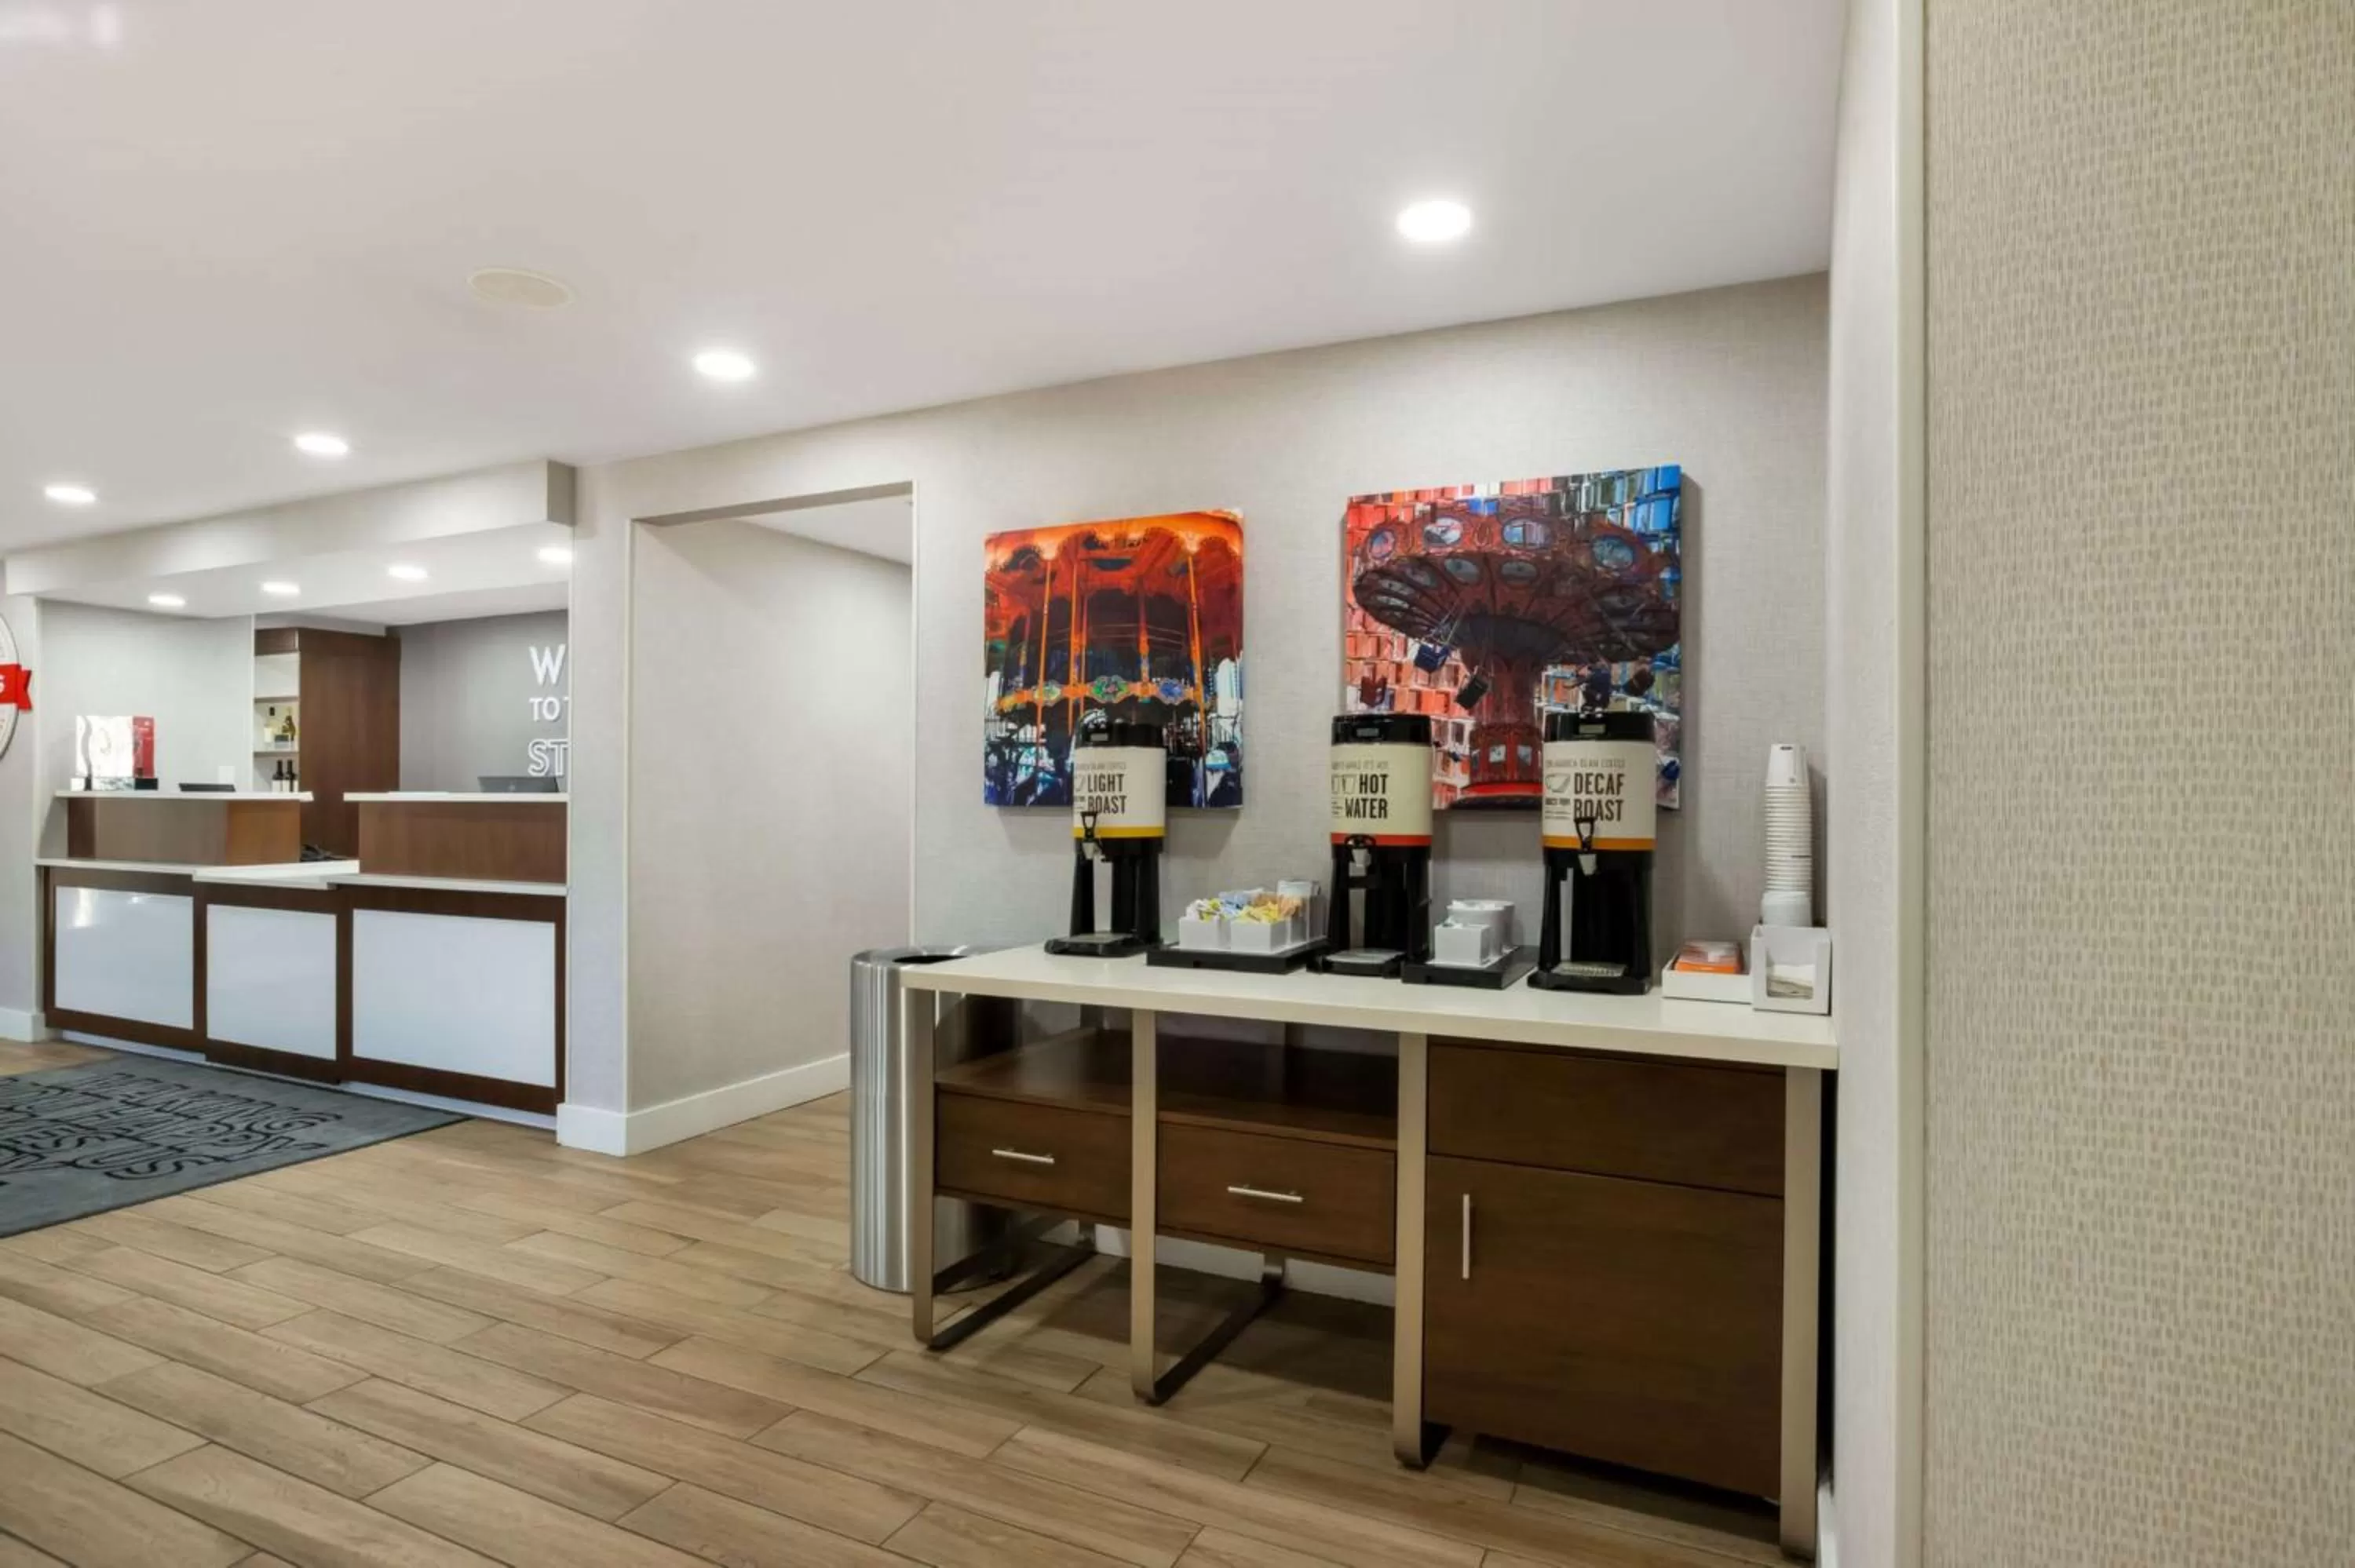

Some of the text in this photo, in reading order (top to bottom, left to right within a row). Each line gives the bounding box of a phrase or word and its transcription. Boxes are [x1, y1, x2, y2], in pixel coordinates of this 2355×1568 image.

[528, 697, 560, 721] TO
[1087, 774, 1125, 793] LIGHT
[1359, 774, 1389, 795] HOT
[1574, 772, 1625, 796] DECAF
[1087, 795, 1127, 815] ROAST
[1345, 797, 1388, 819] WATER
[1574, 798, 1624, 822] ROAST
